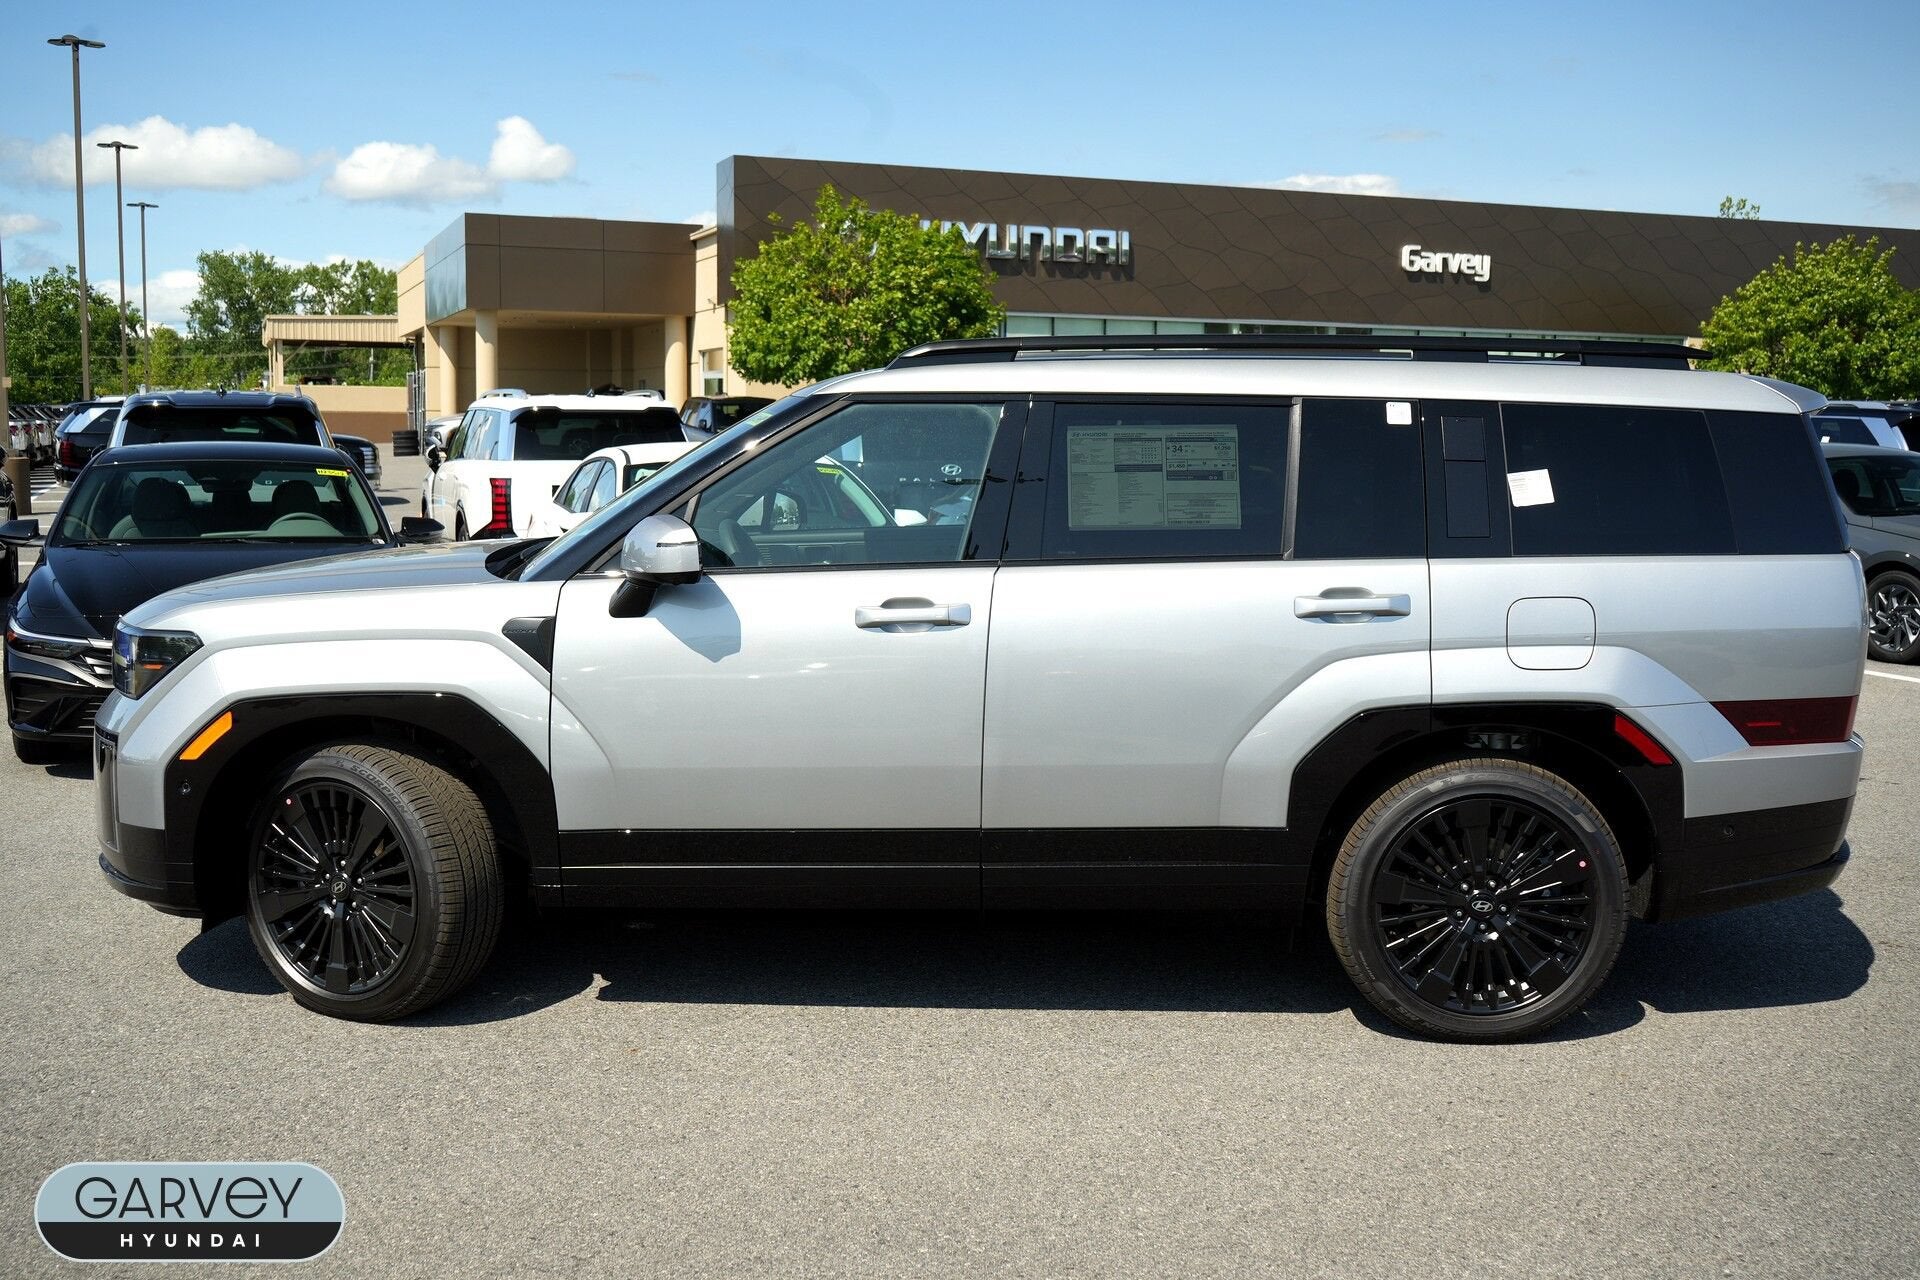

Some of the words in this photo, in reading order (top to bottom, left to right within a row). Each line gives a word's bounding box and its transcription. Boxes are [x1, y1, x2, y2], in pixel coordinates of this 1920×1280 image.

[920, 219, 1130, 265] YUNDAI
[1401, 244, 1491, 282] Garvey
[1171, 445, 1183, 453] 34
